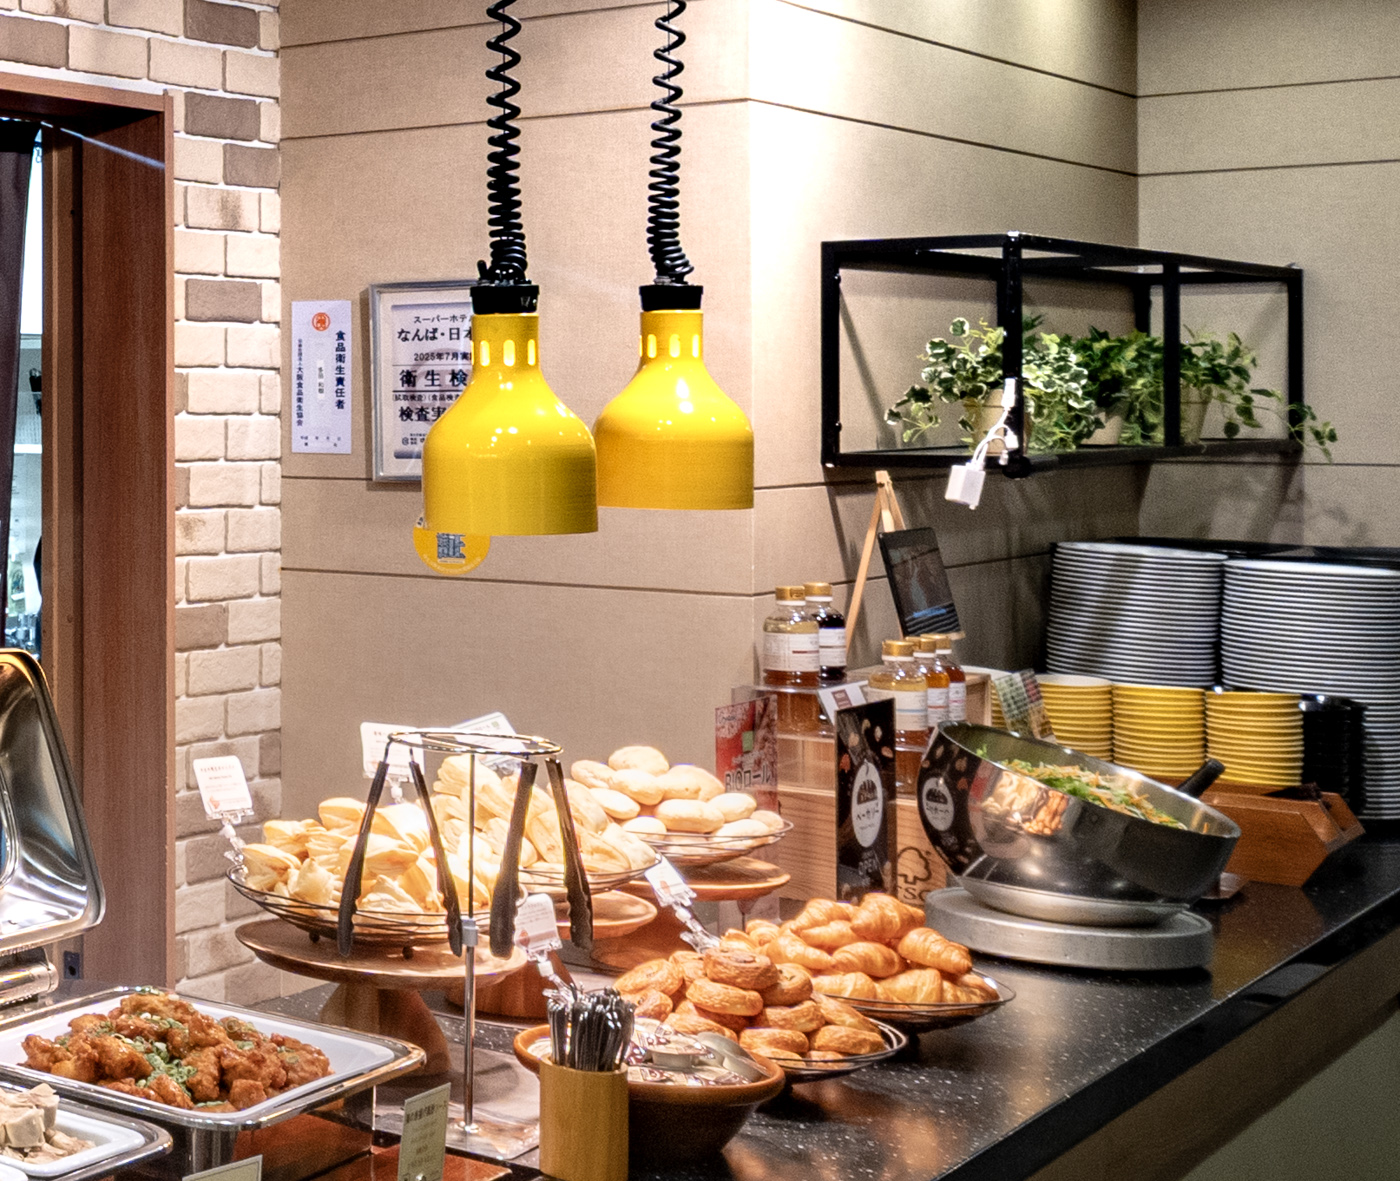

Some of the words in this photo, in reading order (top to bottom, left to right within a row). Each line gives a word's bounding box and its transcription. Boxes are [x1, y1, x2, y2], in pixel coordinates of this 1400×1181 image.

[414, 314, 472, 324] スーパーホテ
[414, 351, 472, 362] 2025年7月実
[335, 330, 346, 410] 食品衛生責任者
